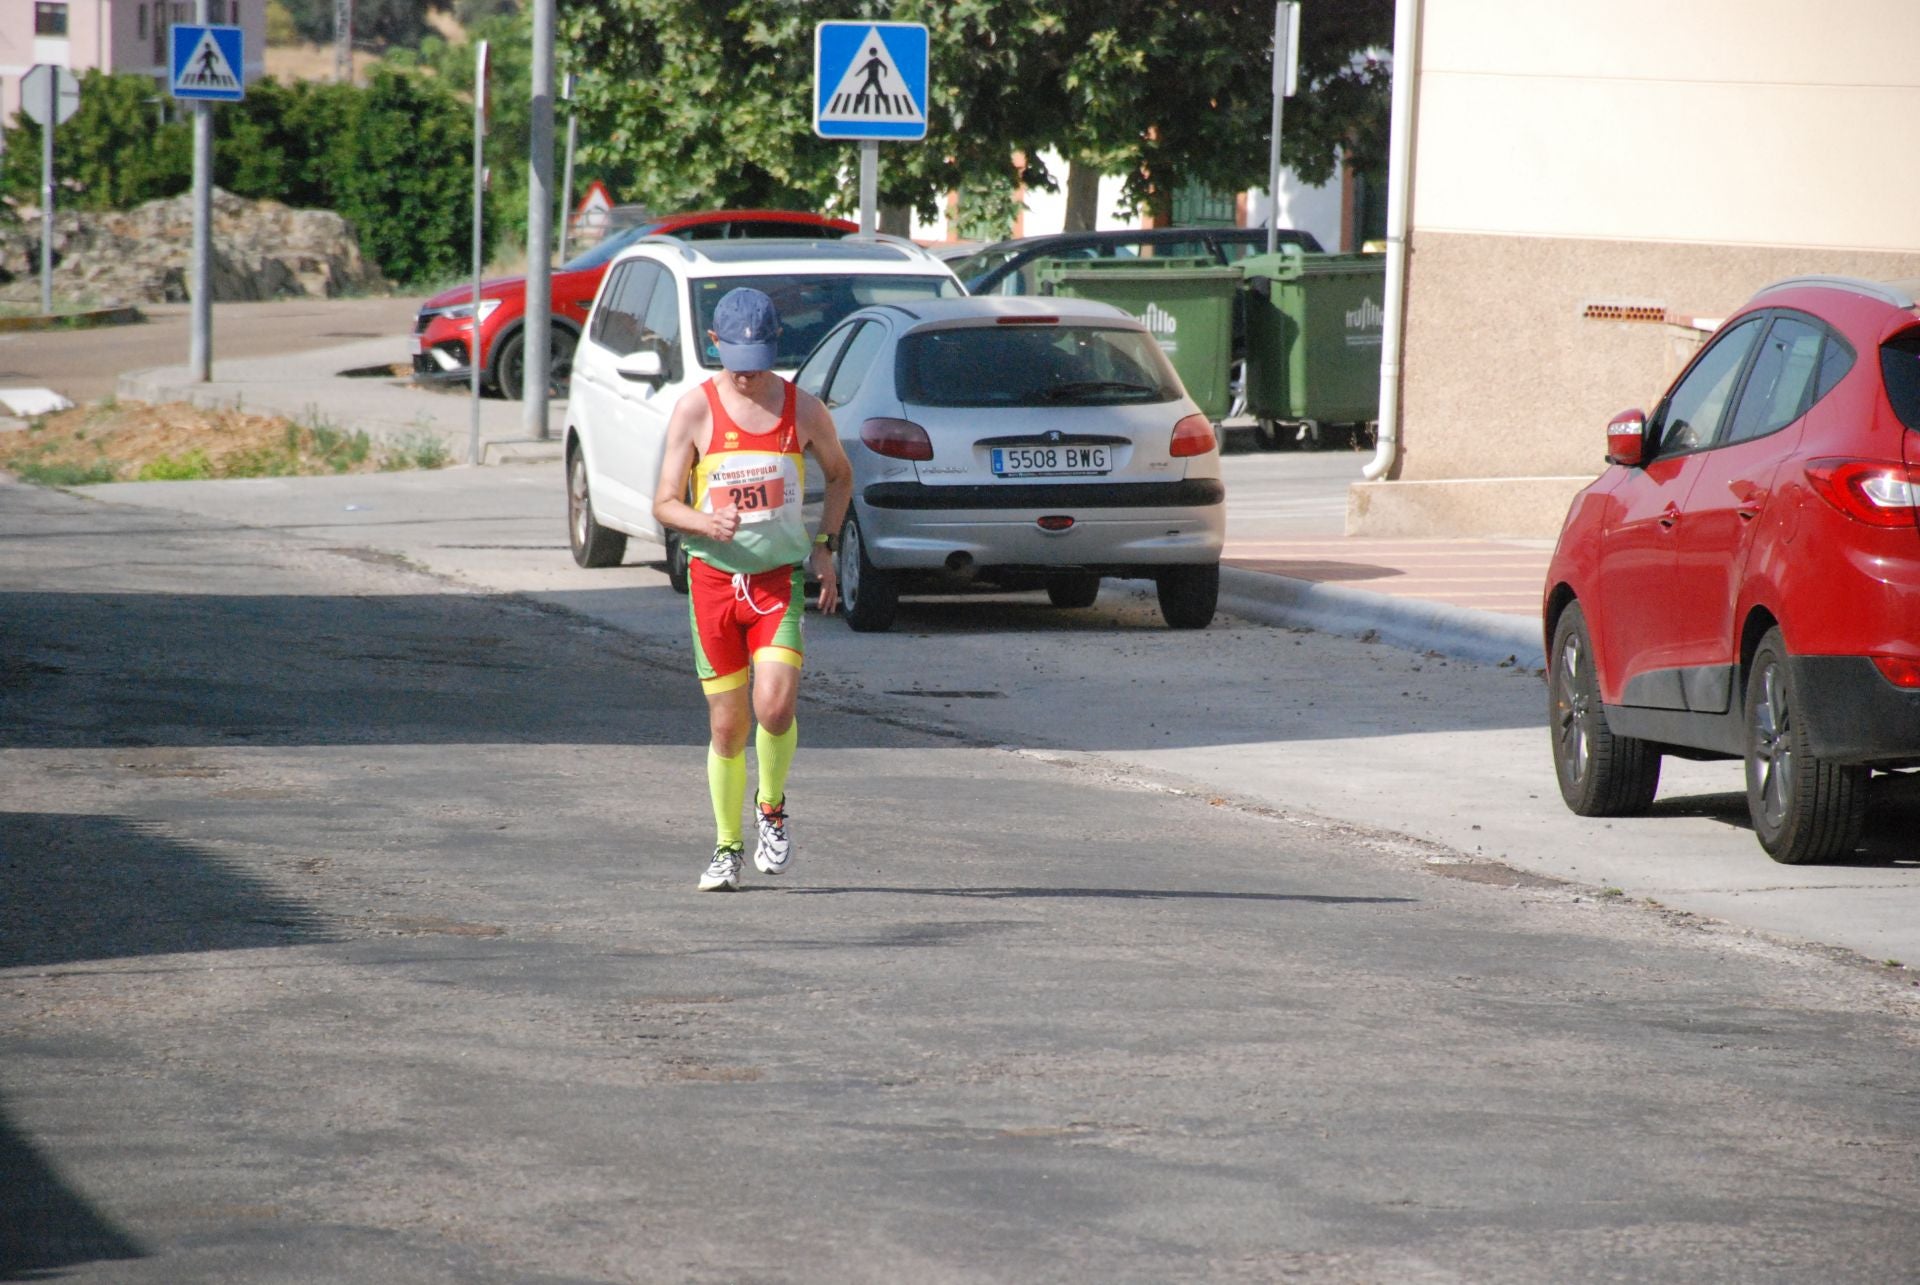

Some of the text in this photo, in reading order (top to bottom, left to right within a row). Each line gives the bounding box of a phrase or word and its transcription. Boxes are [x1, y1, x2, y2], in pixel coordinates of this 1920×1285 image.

[1008, 449, 1105, 469] 5508 BWG
[721, 470, 745, 479] CROSS
[746, 465, 777, 476] POPULAR
[729, 484, 768, 510] 251
